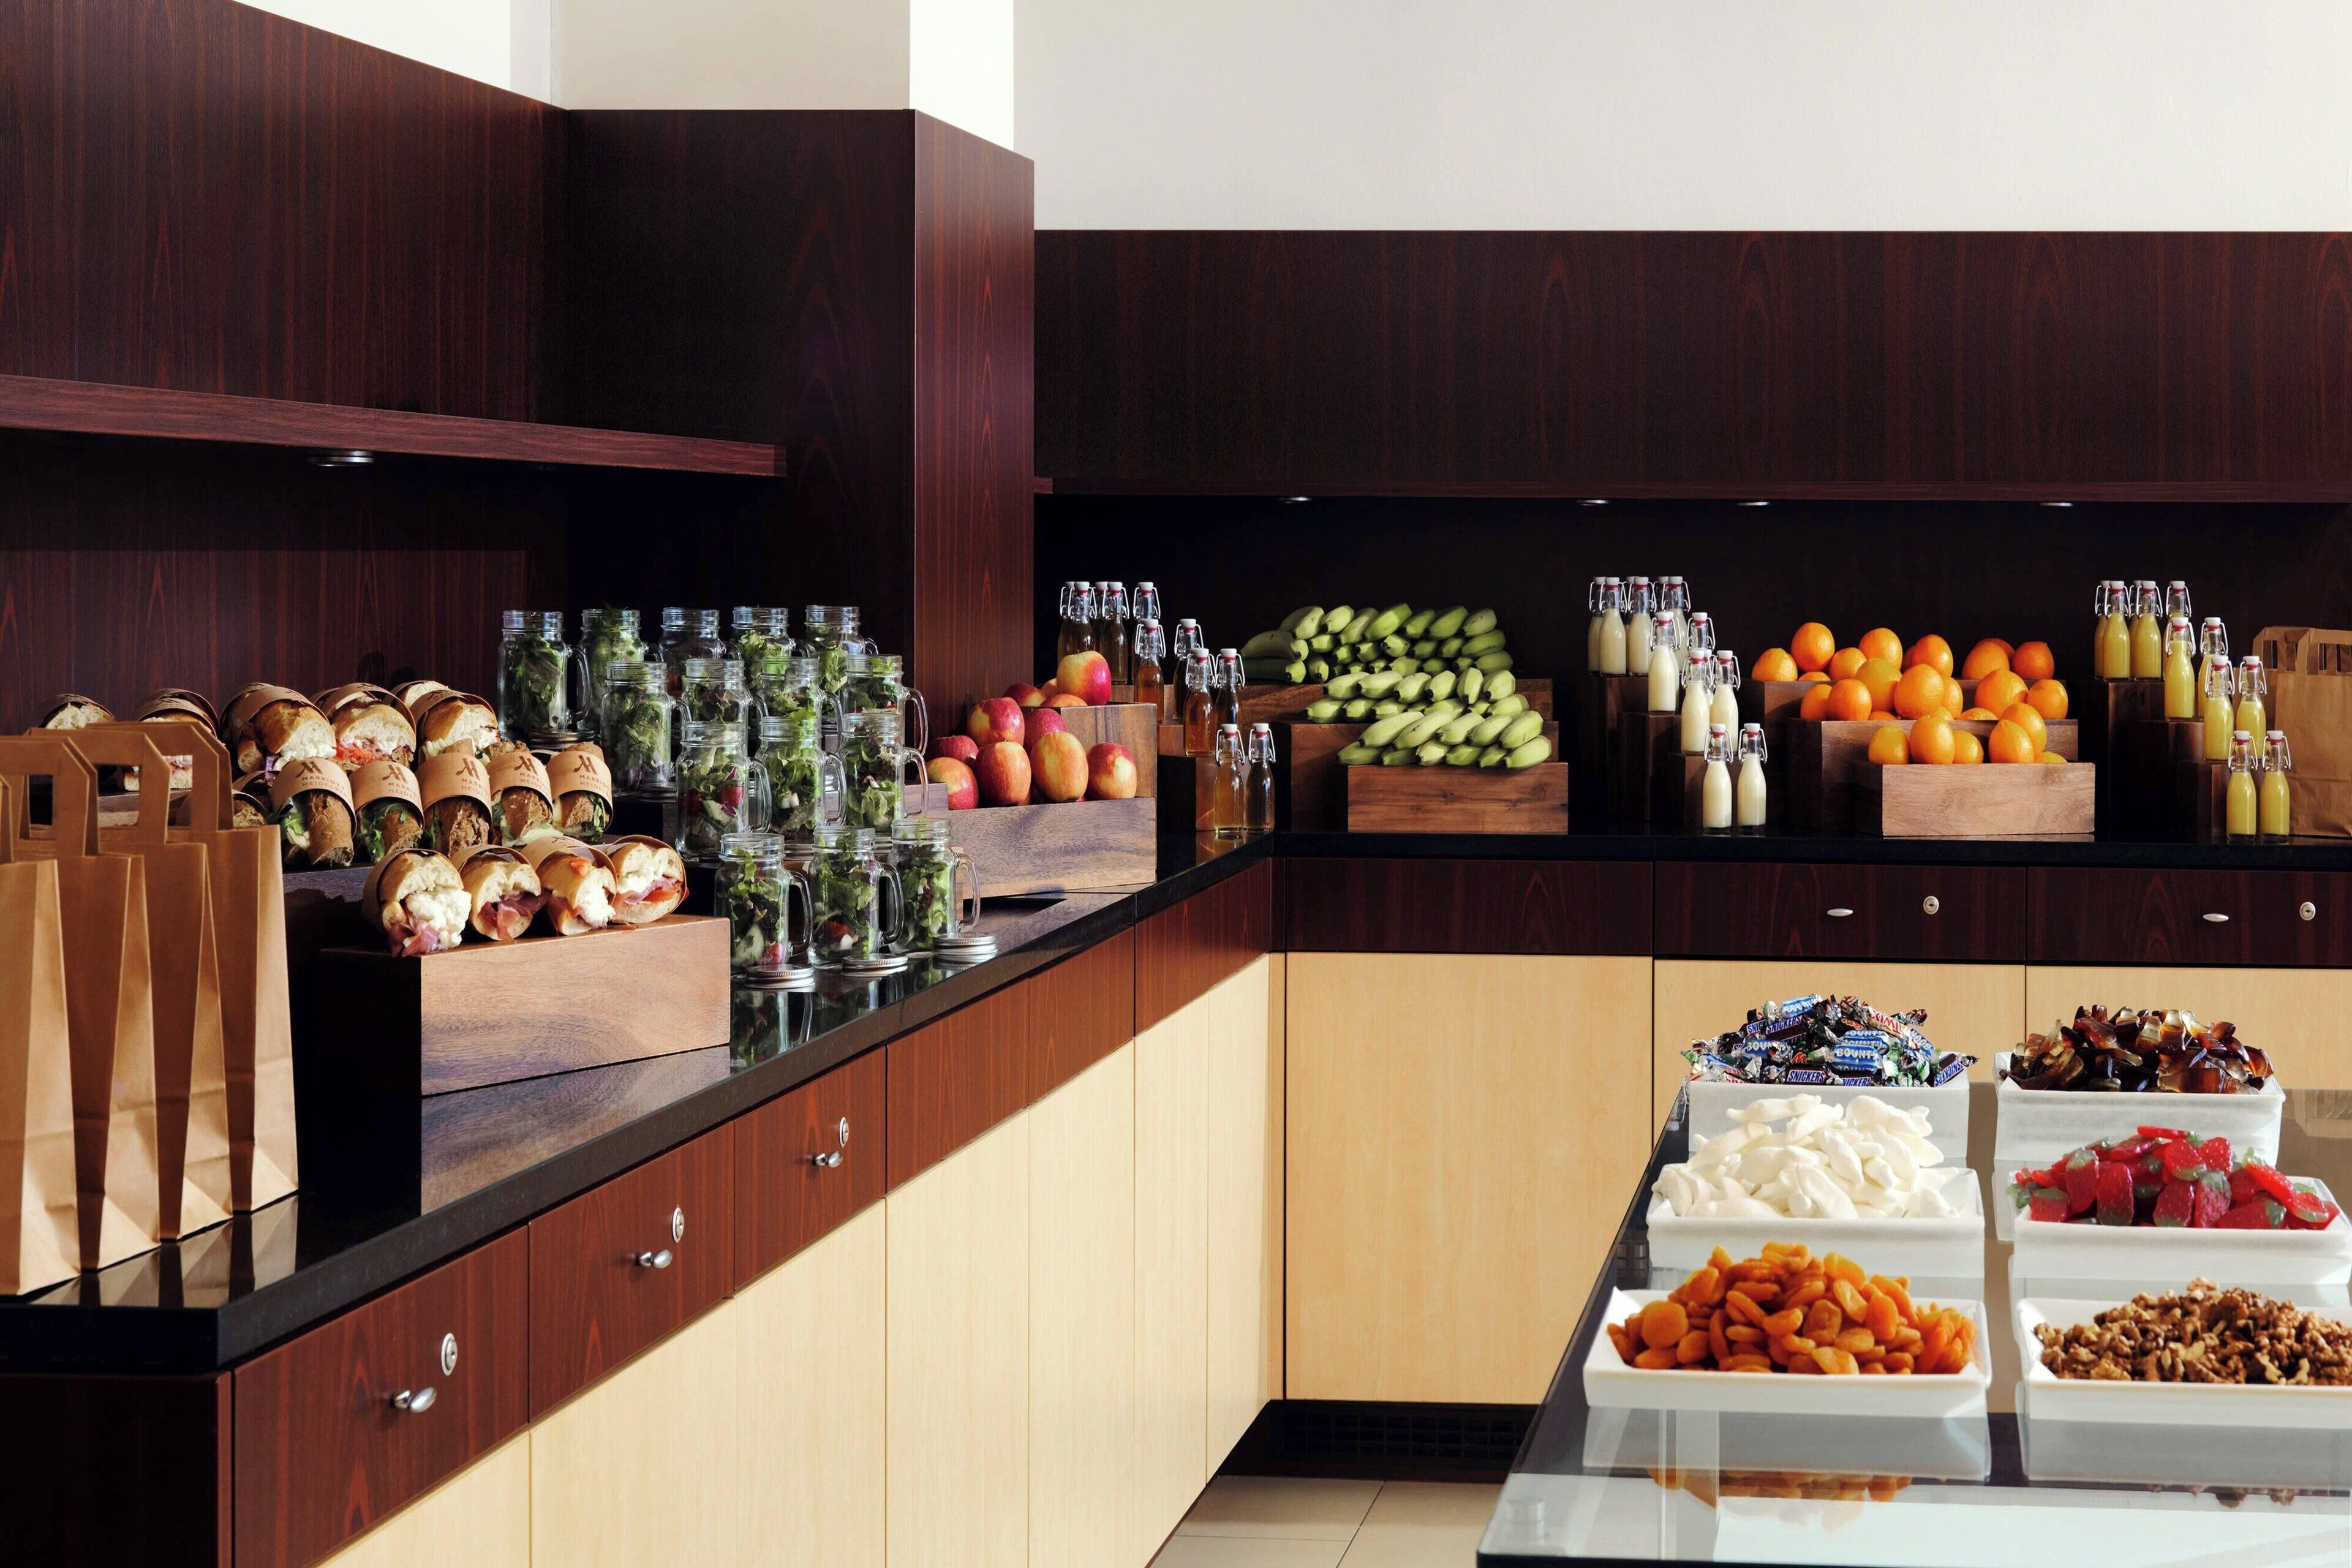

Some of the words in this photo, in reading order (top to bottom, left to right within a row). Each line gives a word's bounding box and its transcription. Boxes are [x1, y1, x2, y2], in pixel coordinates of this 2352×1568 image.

[1766, 1015, 1802, 1034] SNICKERS
[1874, 1011, 1902, 1036] TWIX
[1909, 1029, 1933, 1050] BOUN
[1788, 1070, 1825, 1083] SNICKERS
